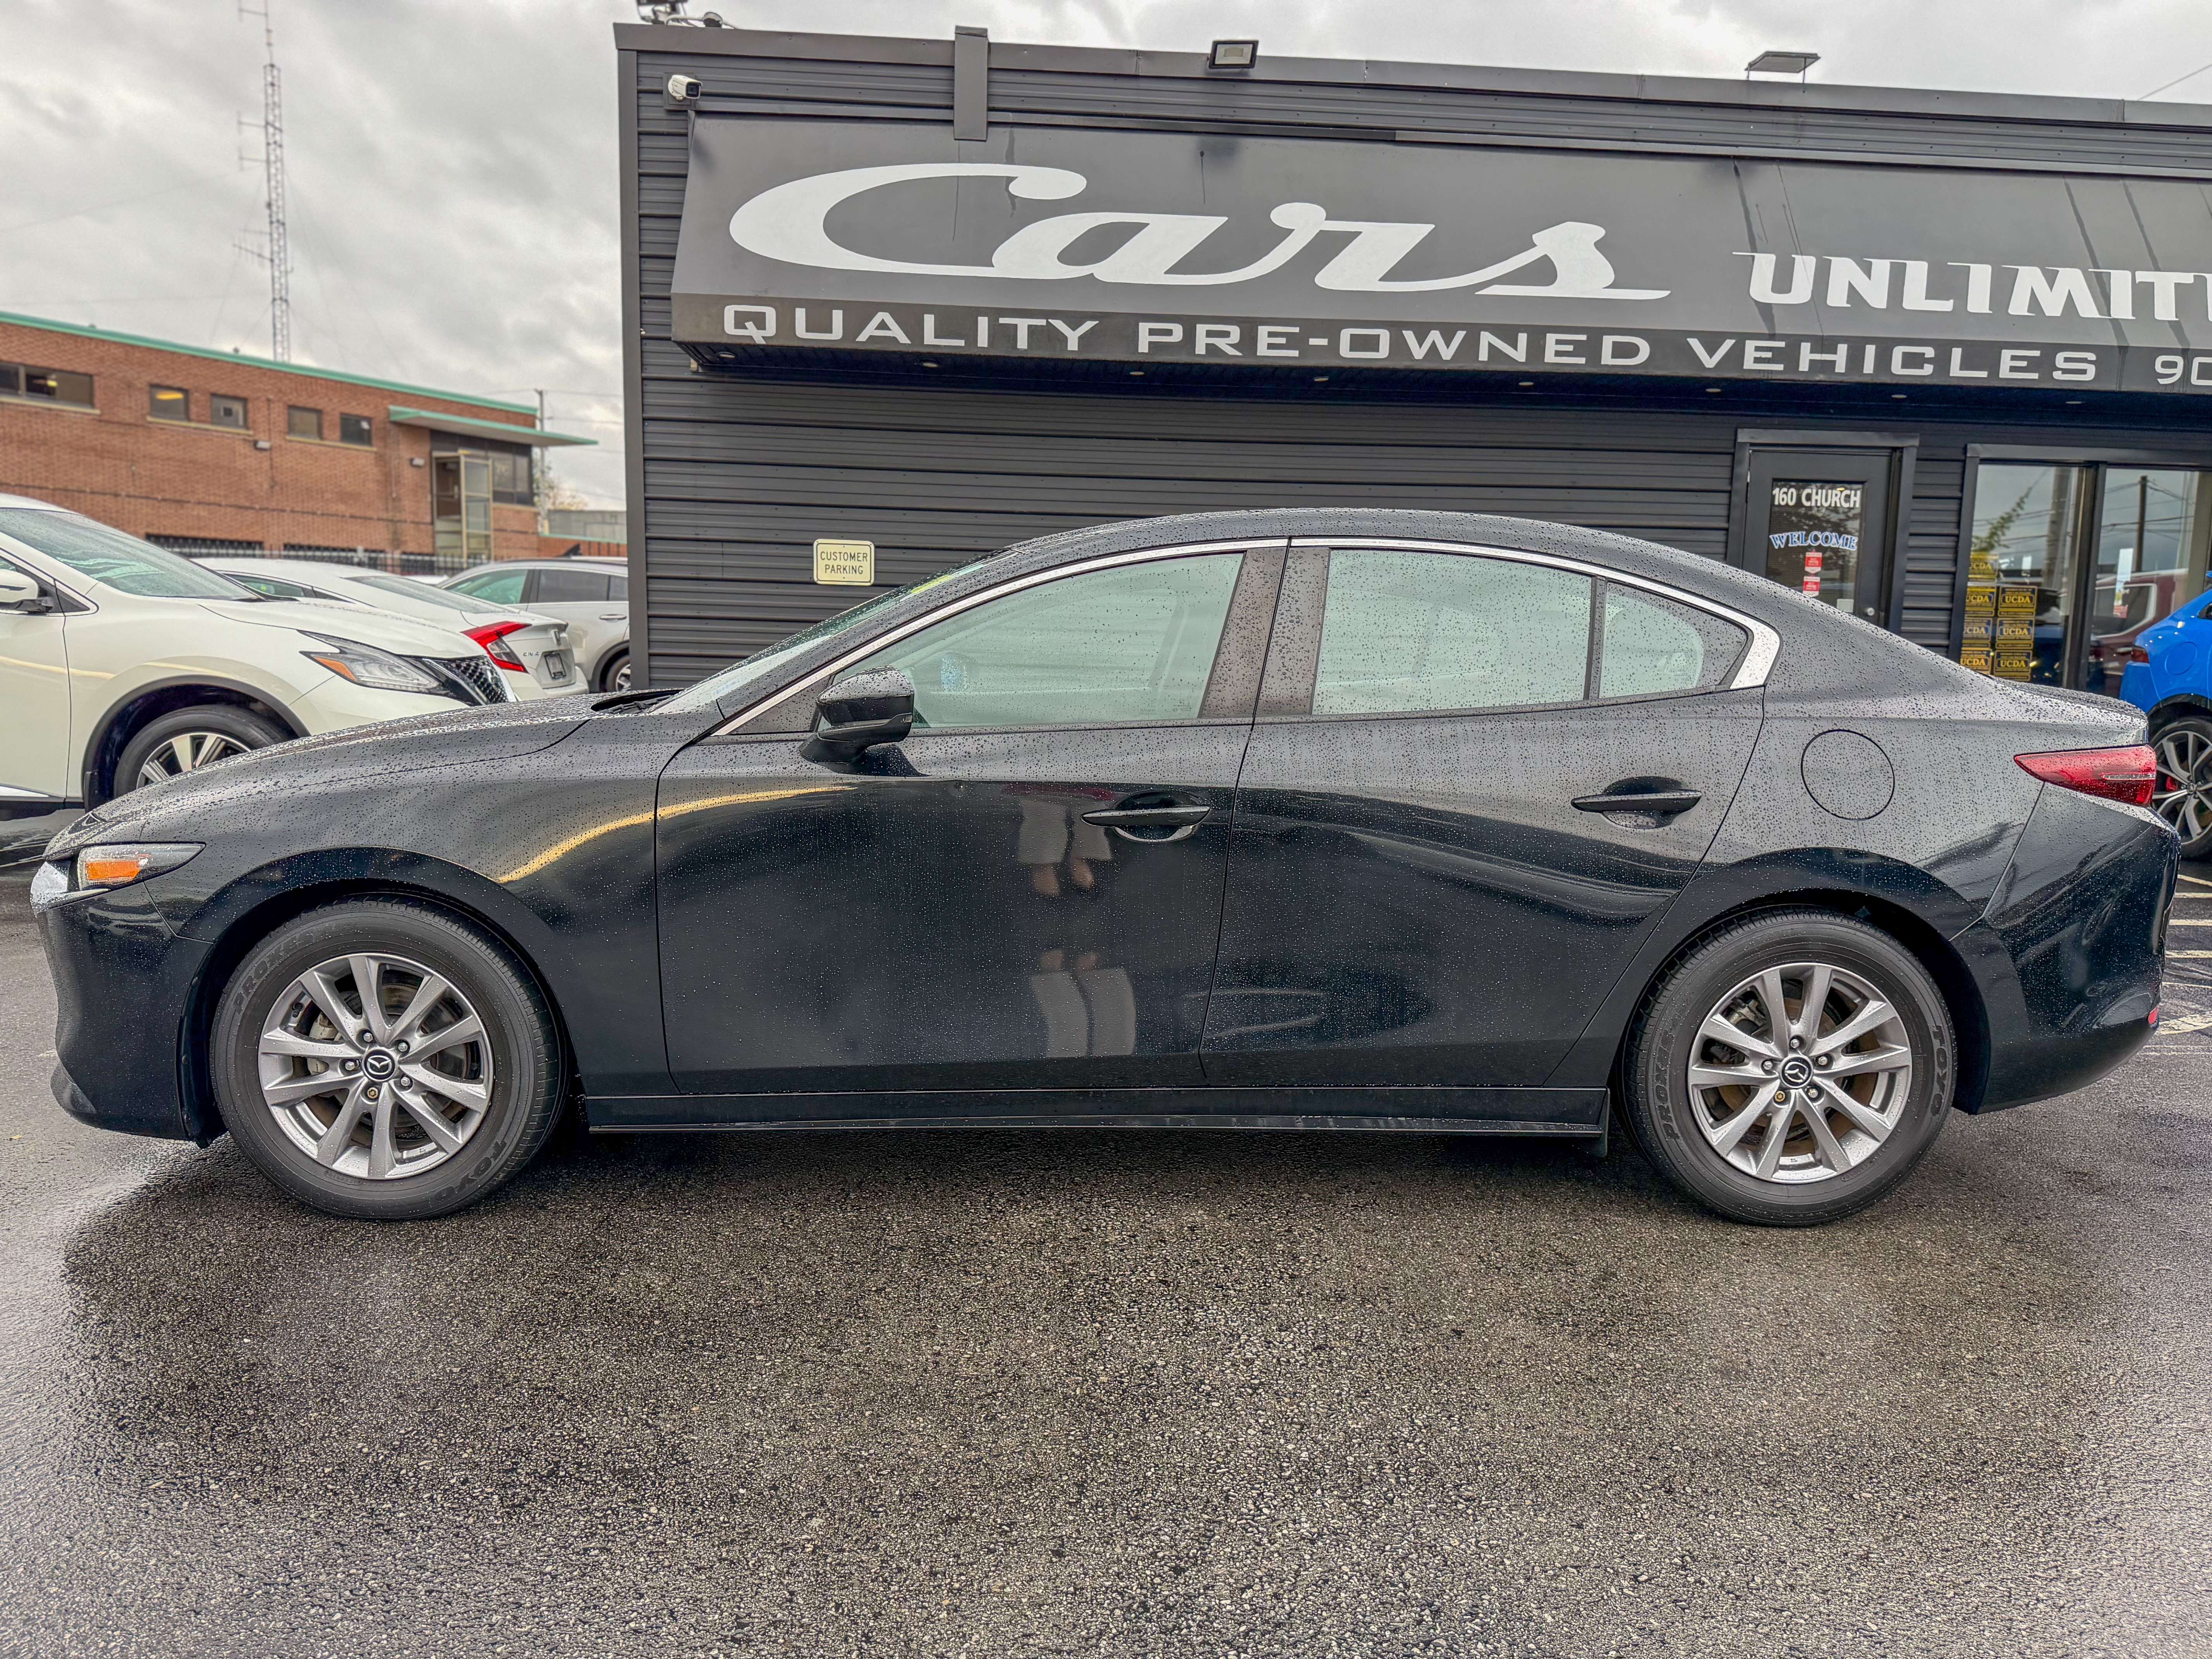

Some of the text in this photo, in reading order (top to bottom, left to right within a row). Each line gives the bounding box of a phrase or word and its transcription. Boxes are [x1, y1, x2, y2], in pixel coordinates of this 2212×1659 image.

[730, 163, 2212, 322] Cars UNLIMIT
[724, 304, 1099, 351] QUALITY
[1138, 322, 1650, 366] PRE-OWNED
[1686, 338, 2096, 381] VEHICLES
[1772, 488, 1861, 508] 160 CHURCH
[820, 551, 868, 562] CUSTOMER
[825, 564, 863, 574] PARKING
[1769, 531, 1858, 551] WELCOME
[233, 931, 314, 1015] PROXES
[1656, 1029, 1680, 1139] PROXES
[1931, 1025, 1948, 1116] TOYO
[433, 1140, 507, 1202] TOYO
